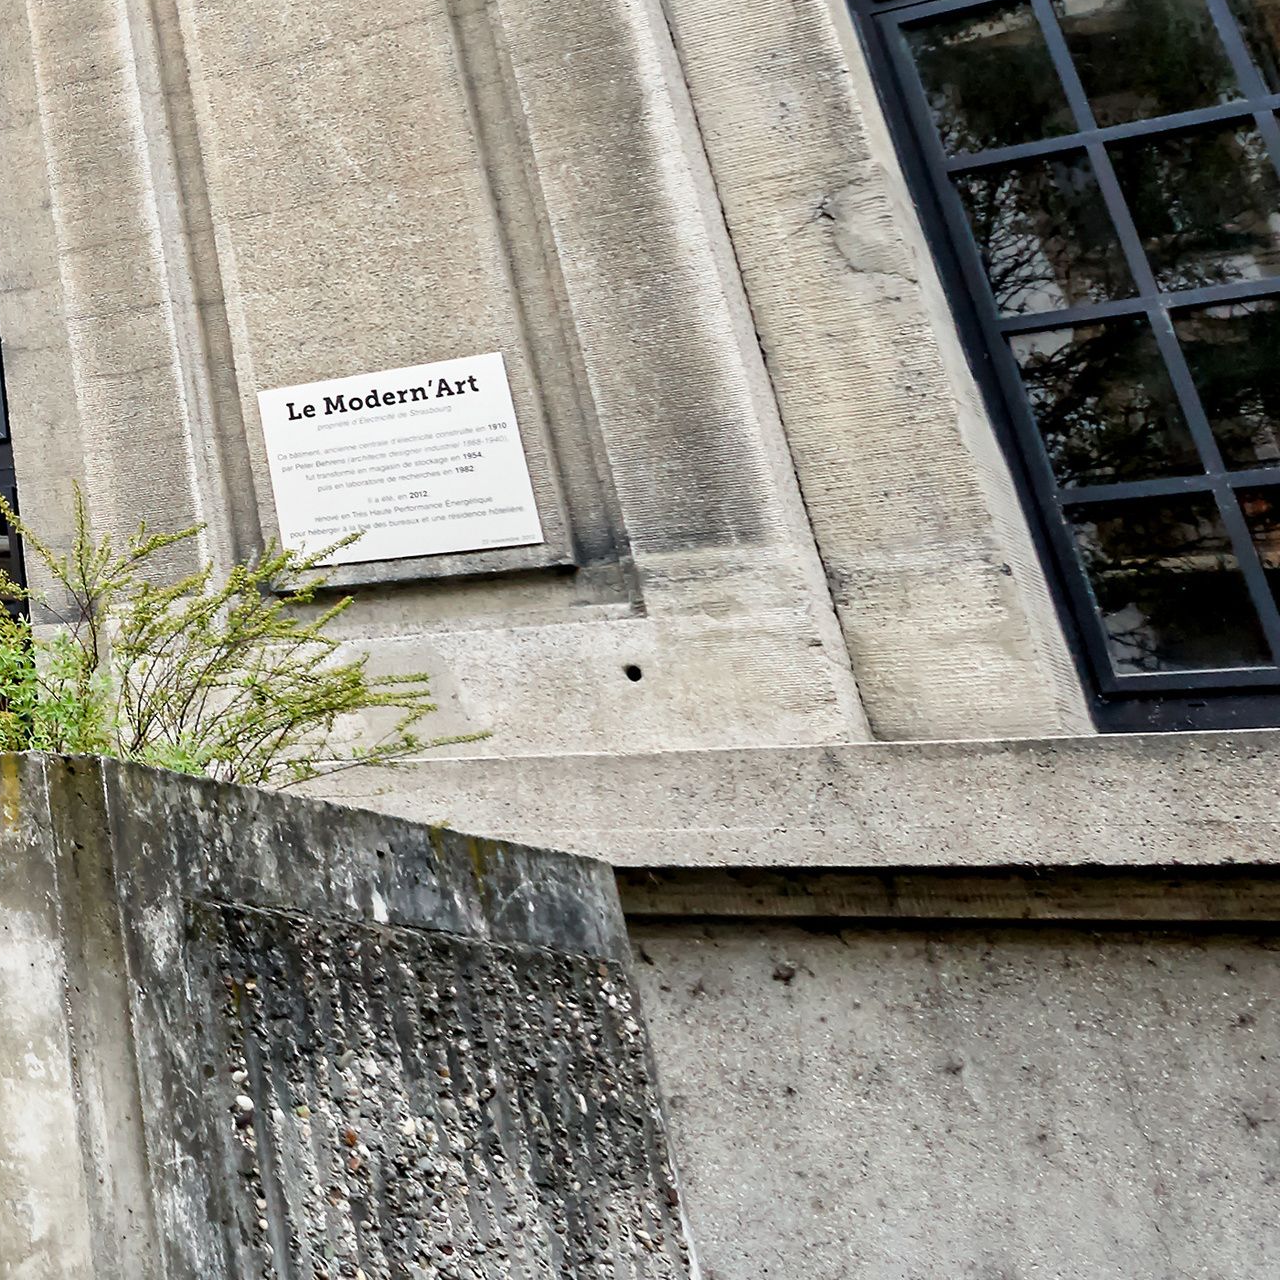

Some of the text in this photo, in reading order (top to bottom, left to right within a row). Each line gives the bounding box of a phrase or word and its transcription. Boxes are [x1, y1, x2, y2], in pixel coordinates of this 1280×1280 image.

[286, 374, 480, 422] Le Modern'Art
[409, 404, 452, 417] Strasbourg
[487, 421, 507, 431] 1910
[414, 456, 449, 467] stockage
[409, 490, 429, 499] 2012
[369, 508, 392, 516] Haute
[393, 502, 443, 513] Performance
[388, 518, 419, 527] bureaux
[448, 510, 487, 519] résidence
